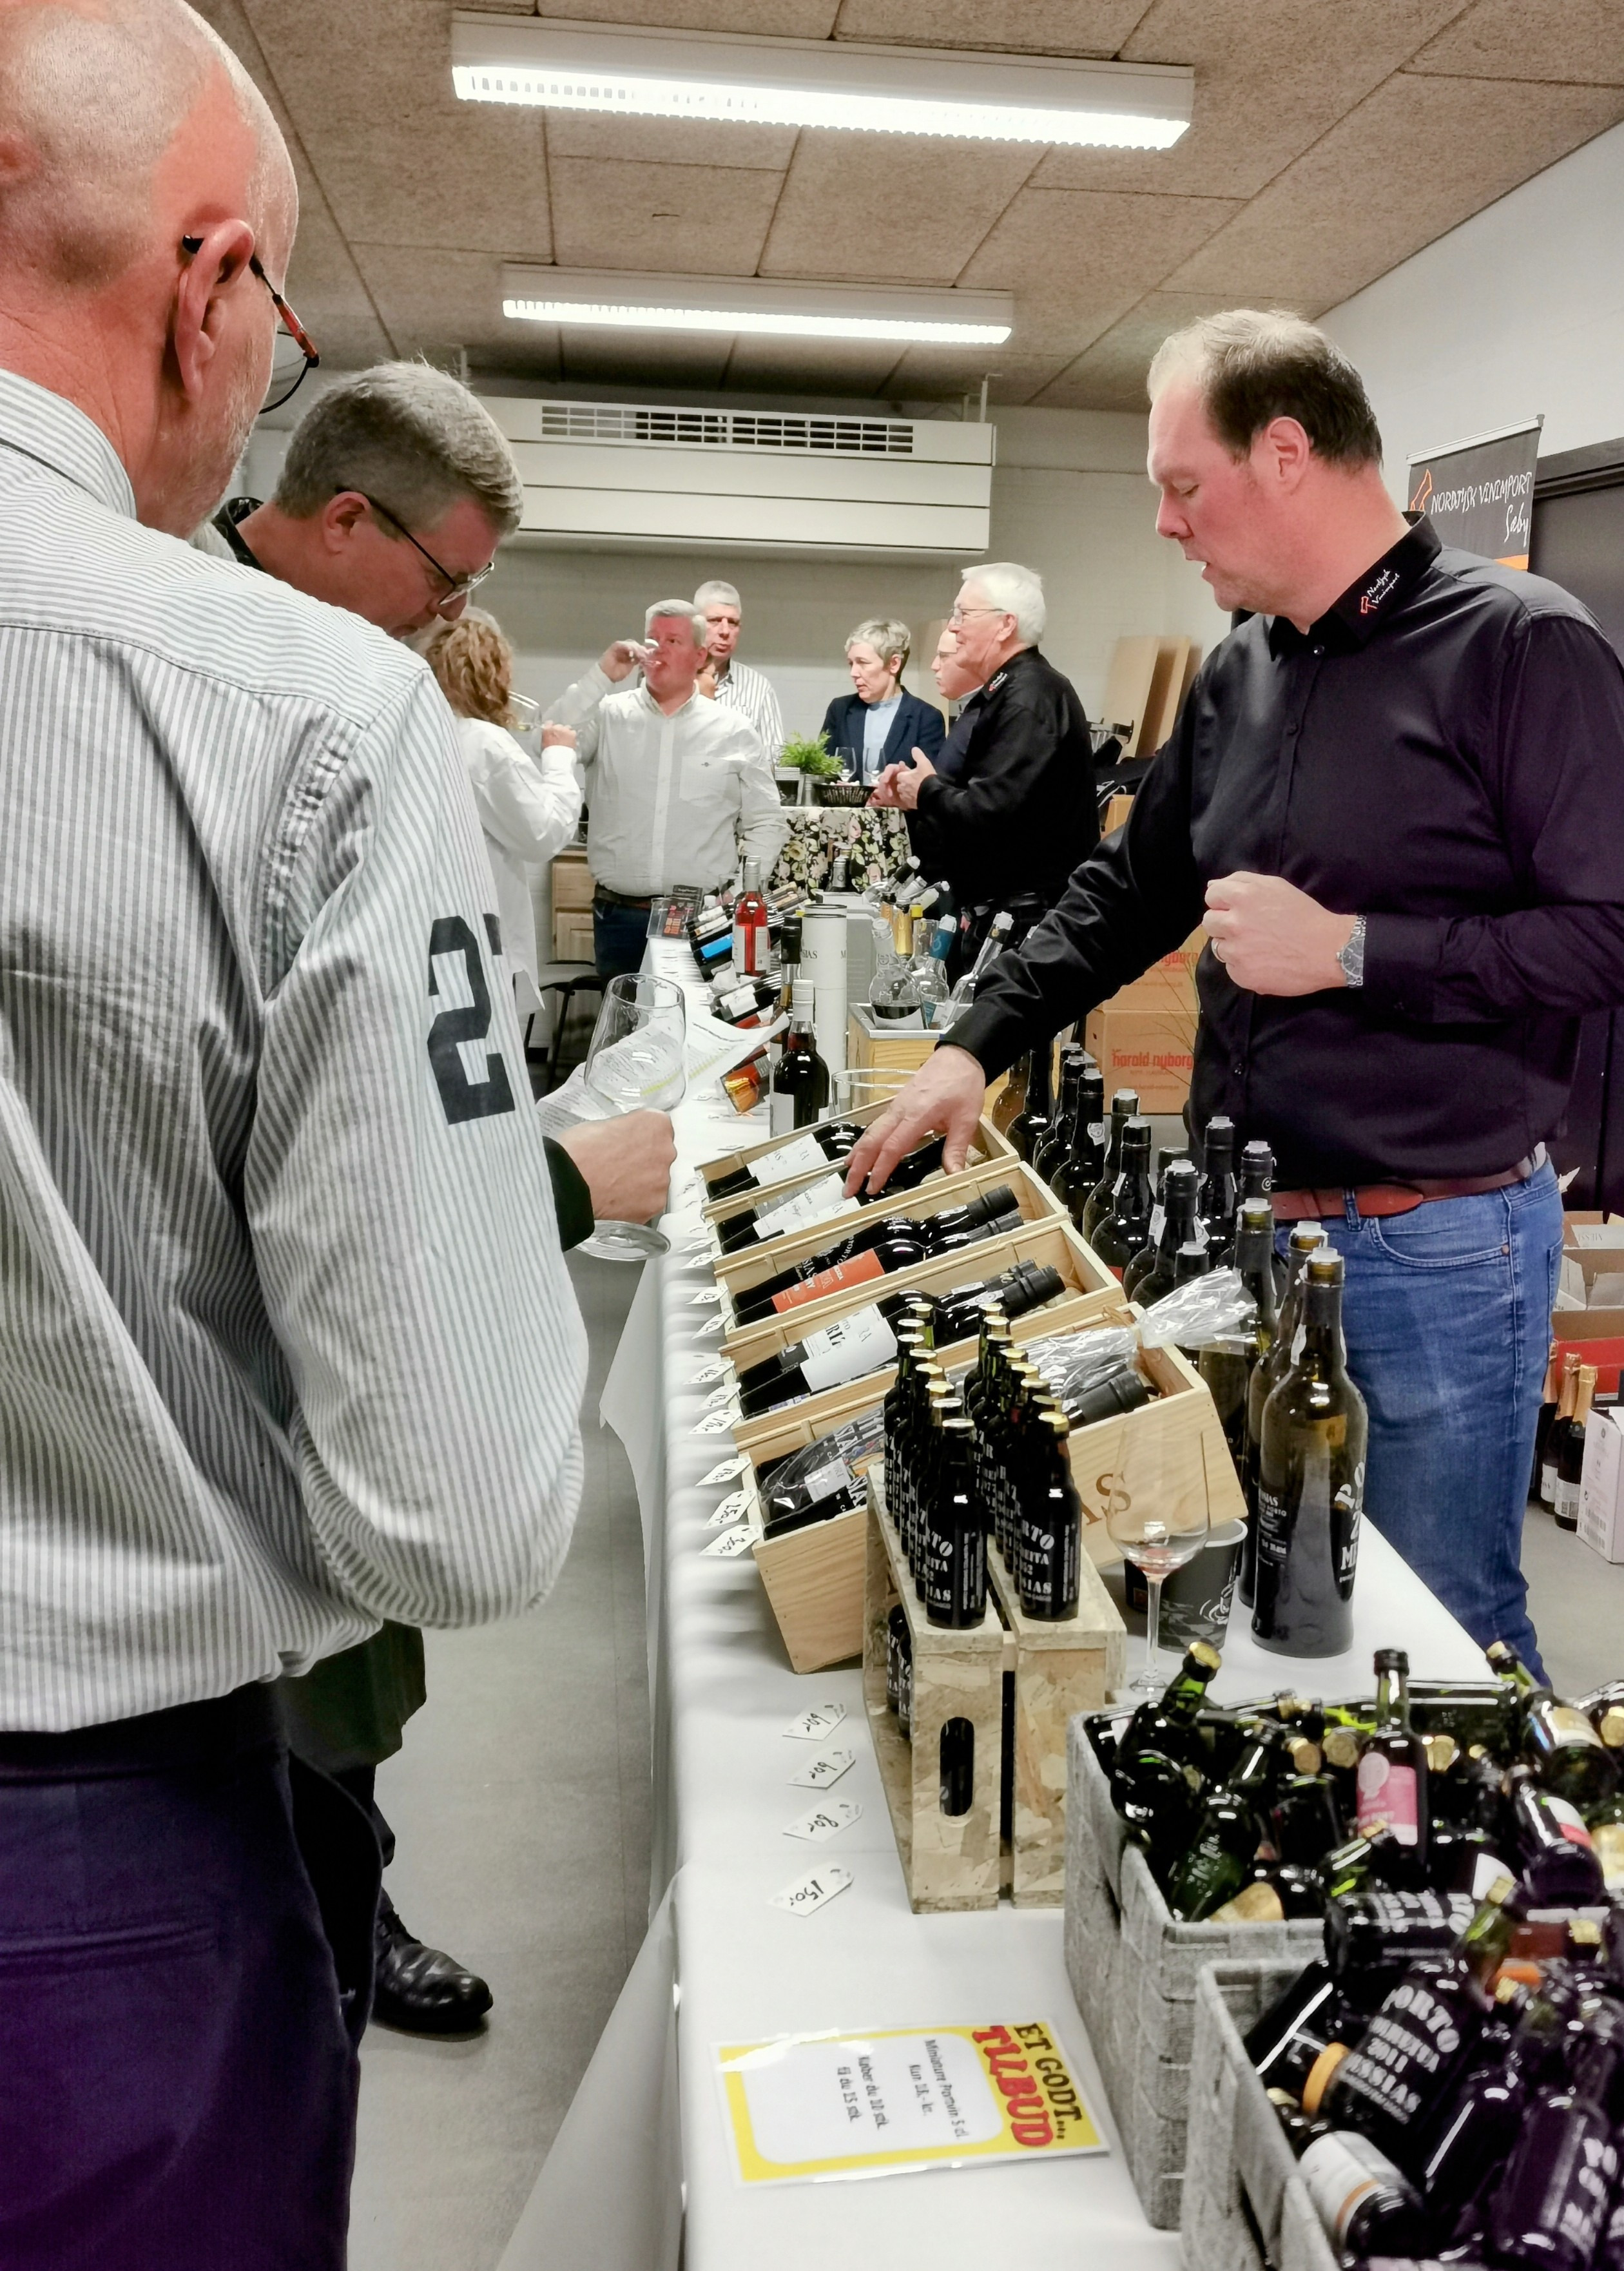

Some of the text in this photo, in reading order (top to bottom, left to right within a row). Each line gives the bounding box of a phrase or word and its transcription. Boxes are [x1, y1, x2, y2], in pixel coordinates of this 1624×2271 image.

[1479, 472, 1532, 504] VINIMPORT
[427, 913, 515, 1125] 2
[1014, 2024, 1052, 2051] ET
[840, 2078, 853, 2089] du
[865, 2085, 880, 2096] du
[972, 2025, 1053, 2147] TILBUD
